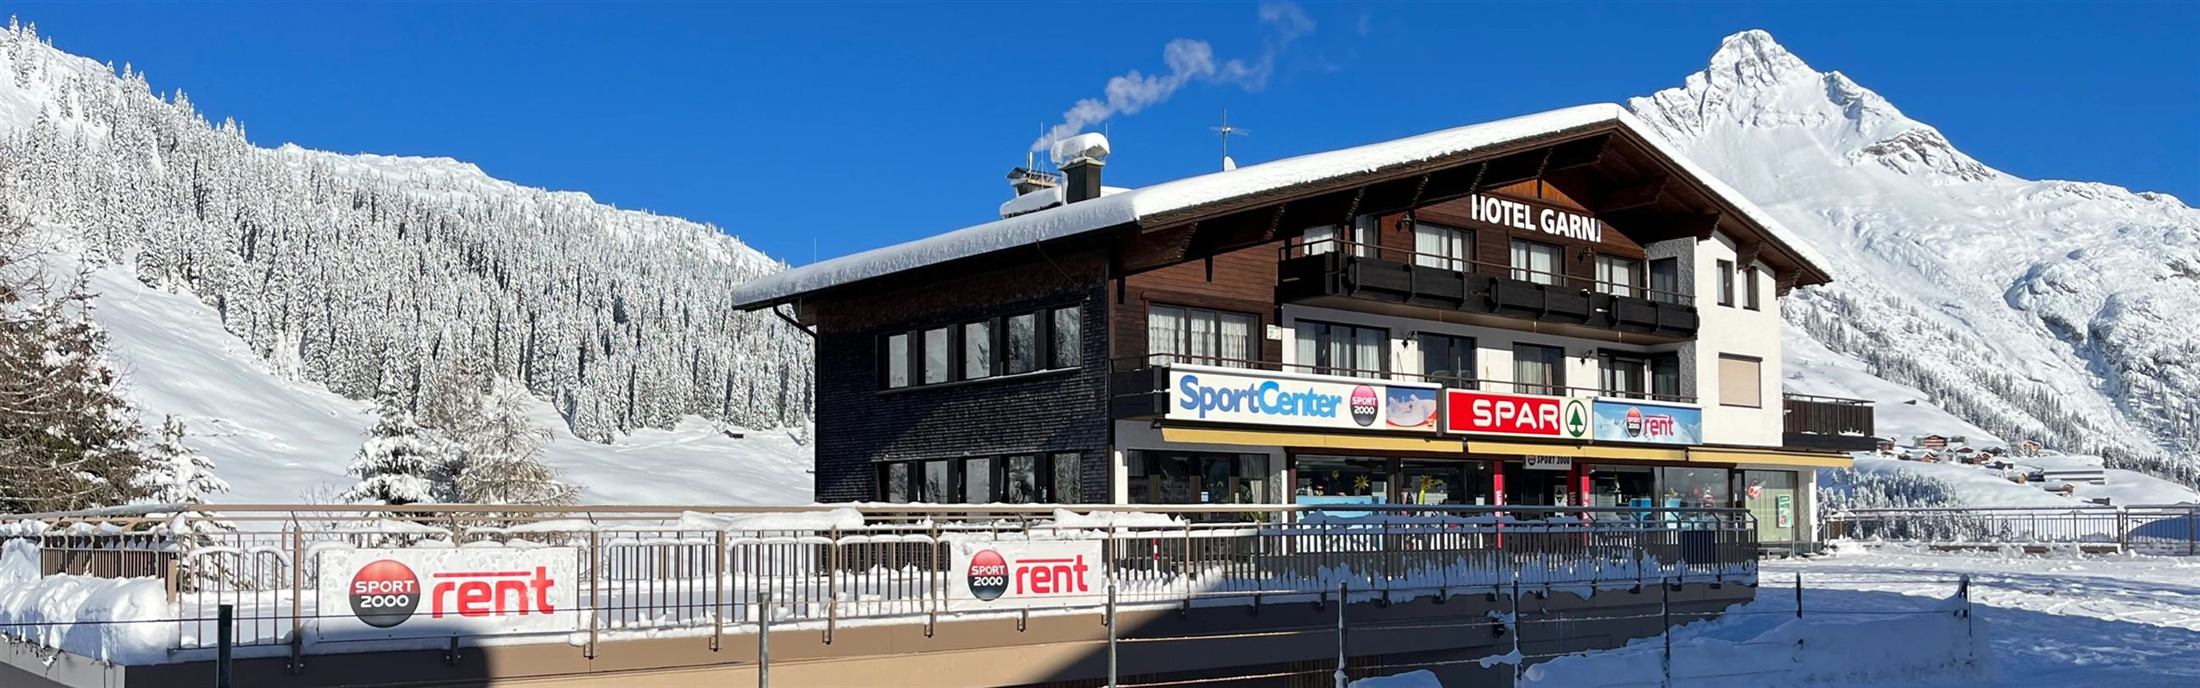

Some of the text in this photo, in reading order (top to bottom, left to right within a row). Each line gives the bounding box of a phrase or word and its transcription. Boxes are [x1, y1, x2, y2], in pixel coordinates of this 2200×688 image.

[1471, 194, 1536, 231] HOTEL
[1180, 374, 1342, 419] SportCenter
[1352, 396, 1376, 406] SPORT
[1354, 405, 1375, 415] 2000
[1472, 398, 1560, 431] SPAR
[1643, 415, 1674, 436] rent
[1537, 455, 1556, 464] SPORT
[1557, 456, 1570, 465] 2000
[971, 565, 1005, 576] SPORT
[1015, 554, 1088, 595] rent
[355, 579, 415, 594] SPORT
[973, 576, 1004, 587] 2000
[432, 565, 555, 619] rent
[360, 594, 410, 609] 2000
